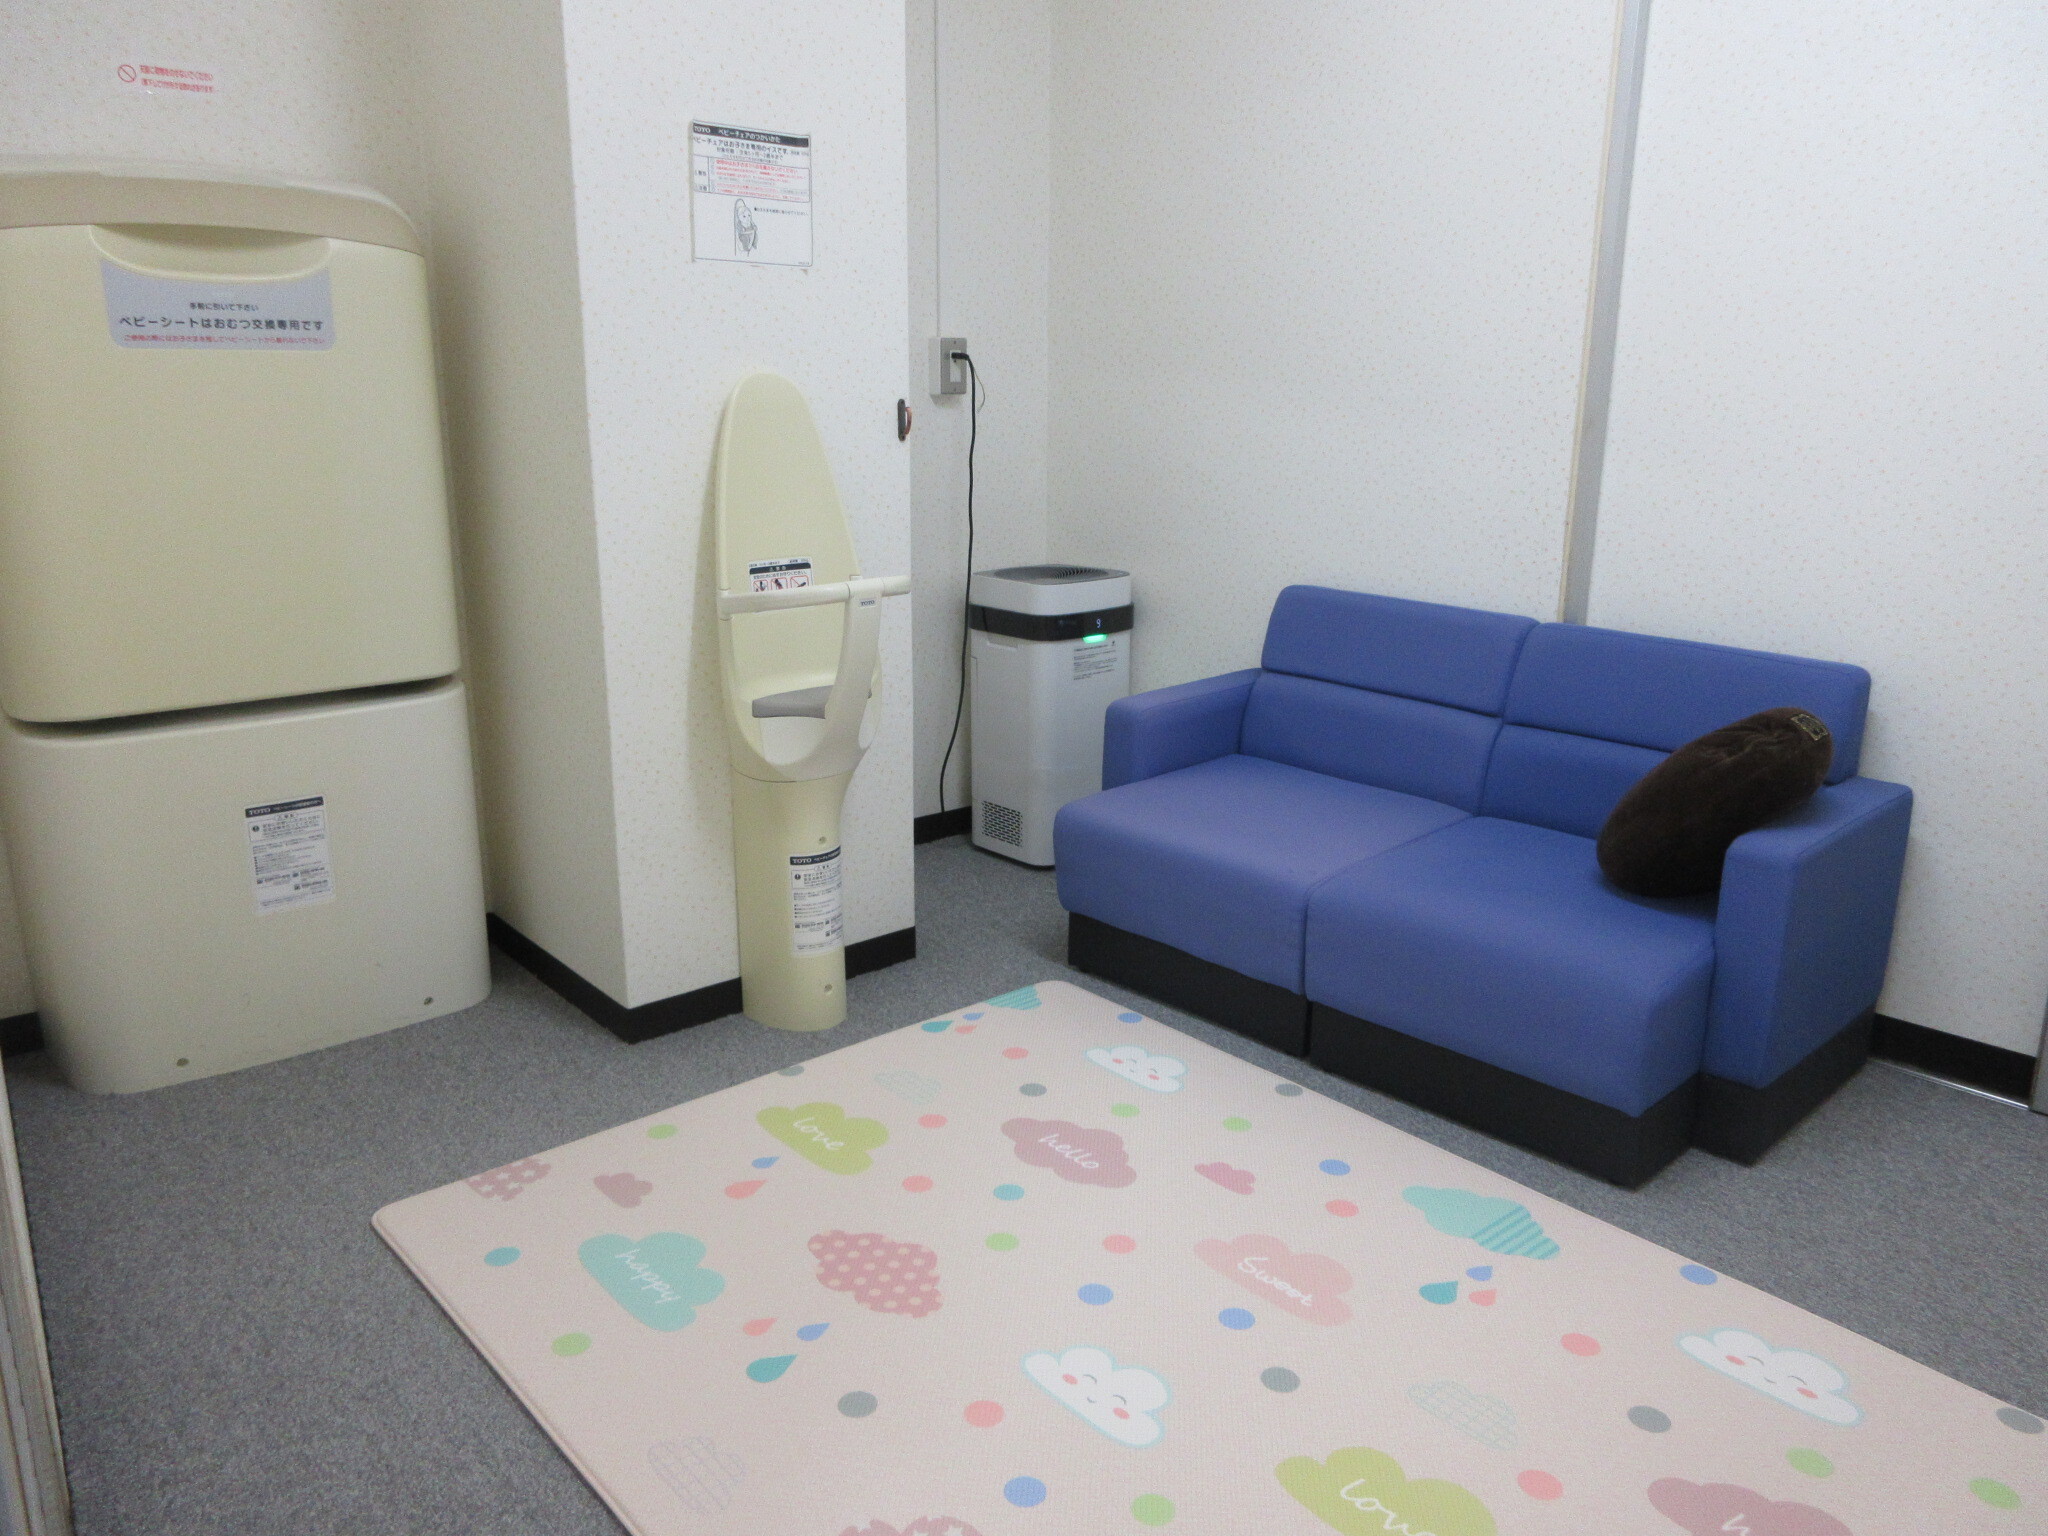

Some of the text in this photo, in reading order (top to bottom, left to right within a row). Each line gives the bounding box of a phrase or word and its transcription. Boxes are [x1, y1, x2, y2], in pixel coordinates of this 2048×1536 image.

[120, 316, 323, 331] ベビーシートはおむつ交換専用です
[249, 807, 271, 815] TOTO
[792, 1116, 845, 1151] love
[1038, 1133, 1100, 1169] hello
[614, 1248, 682, 1304] happy
